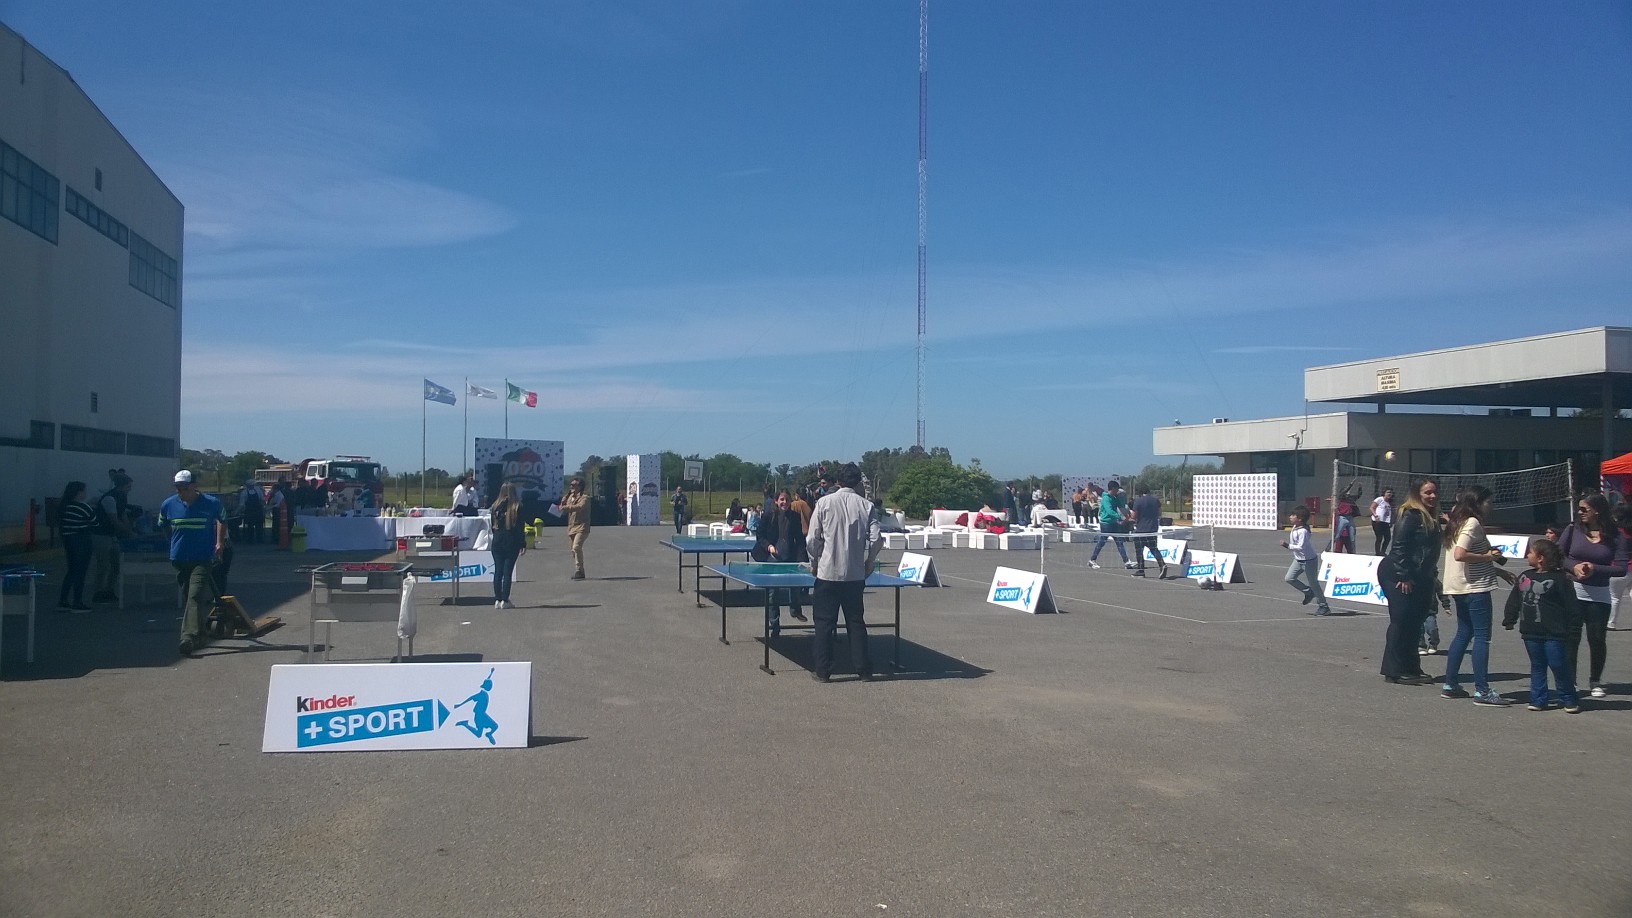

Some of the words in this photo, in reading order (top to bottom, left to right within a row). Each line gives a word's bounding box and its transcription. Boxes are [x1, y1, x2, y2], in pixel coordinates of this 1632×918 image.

[1000, 589, 1019, 599] SPORT
[1340, 585, 1368, 595] SPORT
[297, 694, 356, 713] Kinder
[329, 706, 424, 738] SPORT
